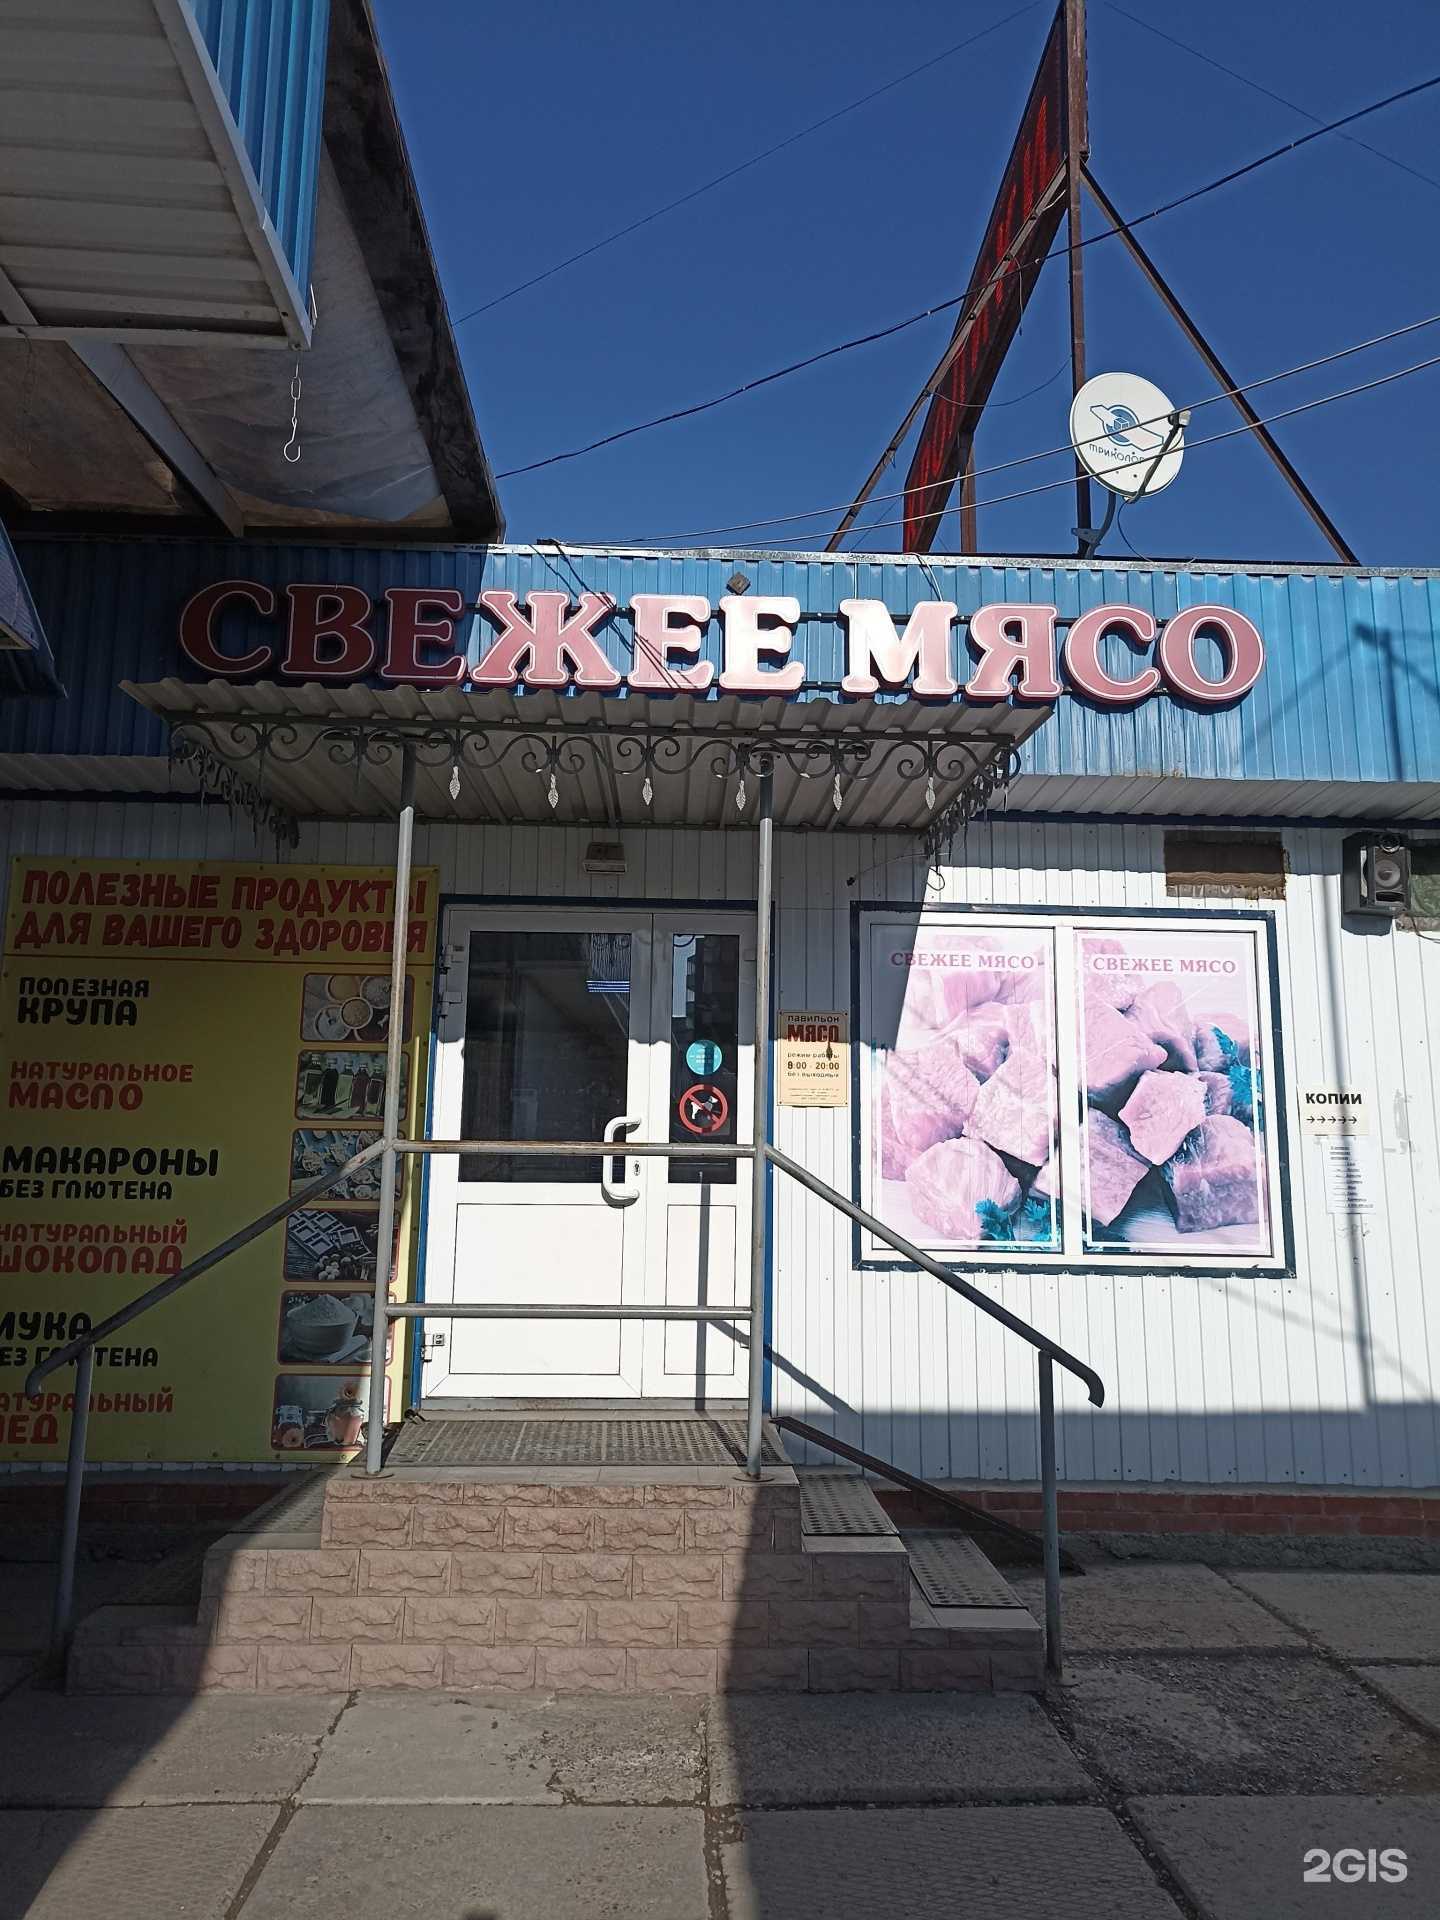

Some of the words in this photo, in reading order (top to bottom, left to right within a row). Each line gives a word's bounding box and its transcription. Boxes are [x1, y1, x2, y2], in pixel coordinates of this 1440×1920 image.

[179, 580, 804, 694] СВЕЖЕЕ
[839, 599, 1265, 702] МЯСО
[22, 869, 221, 909] ПОЛЕЗНЫЕ
[13, 911, 92, 949] ДЛЯ
[102, 912, 242, 949] ВАШЕГО
[890, 952, 972, 967] СВЕЖЕЕ
[978, 954, 1035, 969] МЯСО
[1093, 957, 1174, 972] СВЕЖЕЕ
[1179, 959, 1236, 973] МЯСО
[18, 976, 150, 998] ПОЛЕЗНАЯ
[17, 997, 138, 1026] КРУПА
[787, 1024, 839, 1042] МЯСО
[10, 1060, 194, 1083] НАТУРАЛЬНОЕ
[8, 1082, 144, 1111] МАСЛО
[2, 1145, 219, 1177] МАКАРОНЫ
[0, 1179, 44, 1199] БЕЗ
[51, 1180, 173, 1200] ГЛЮТЕНА
[0, 1218, 187, 1244] НАТУРАЛЬНЫЙ
[0, 1244, 184, 1275] ШОКОЛАД
[35, 1346, 159, 1368] ГТЕНА
[0, 1385, 174, 1413] АТУРАЬНЫЙ
